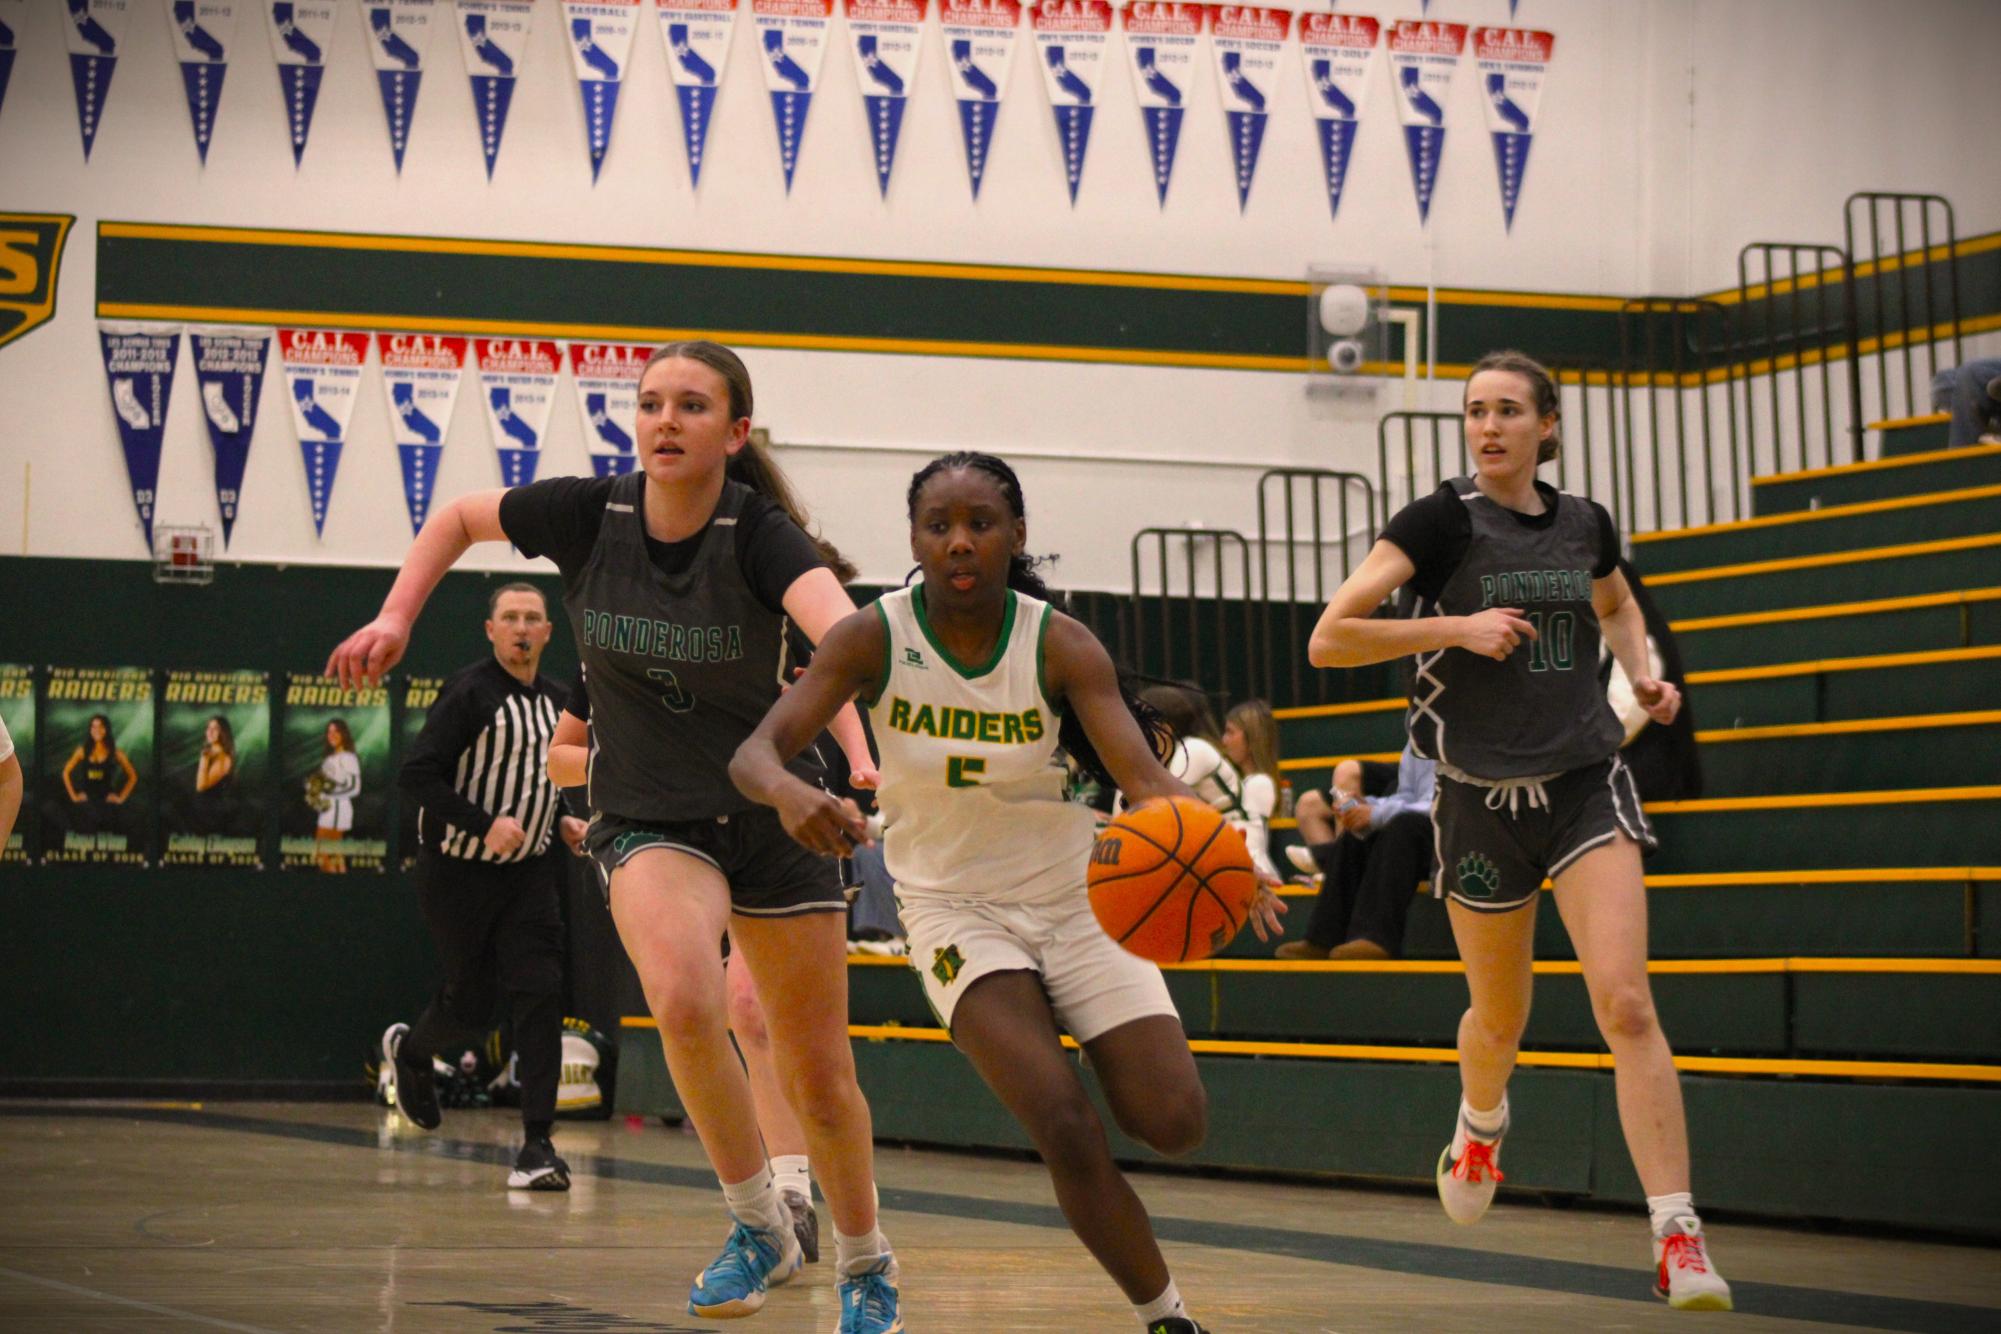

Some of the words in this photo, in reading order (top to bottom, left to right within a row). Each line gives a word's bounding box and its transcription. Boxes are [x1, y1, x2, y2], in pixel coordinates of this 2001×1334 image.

[568, 6, 628, 17] BASEBALL
[755, 1, 826, 17] CHAMPIONS
[850, 7, 918, 22] CHAMPIONS
[1043, 0, 1099, 18] C.A.L.
[1132, 2, 1191, 21] C.A.L.
[1219, 5, 1278, 28] C.A.L.
[943, 12, 1012, 27] CHAMPIONS
[1036, 16, 1105, 32] CHAMPIONS
[1127, 18, 1196, 34] CHAMPIONS
[1309, 13, 1369, 35] C.A.L.
[1214, 22, 1282, 40] CHAMPIONS
[1304, 30, 1372, 48] CHAMPIONS
[1397, 22, 1454, 41] C.A.L.
[1484, 28, 1541, 49] C.A.L.
[1392, 36, 1458, 55] CHAMPIONS
[1479, 44, 1544, 62] CHAMPIONS
[291, 331, 354, 354] C.A.L.
[390, 335, 454, 356] C.A.L.
[487, 340, 549, 362] C.A.L.
[112, 348, 167, 361] 2011-2012
[285, 348, 360, 365] CHAMPIONS
[385, 352, 459, 368] CHAMPIONS
[583, 346, 645, 367] C.A.L.
[108, 361, 171, 374] CHAMPIONS
[199, 361, 262, 374] CHAMPIONS
[482, 356, 555, 373] CHAMPIONS
[578, 363, 643, 378] CHAMPION
[583, 608, 744, 663] PONDEROSA
[1527, 611, 1576, 673] 10
[47, 679, 152, 701] RAIDERS
[165, 682, 268, 704] RAIDERS
[286, 685, 388, 707] RAIDERS
[646, 667, 696, 714] 3
[888, 695, 1045, 745] RAIDERS
